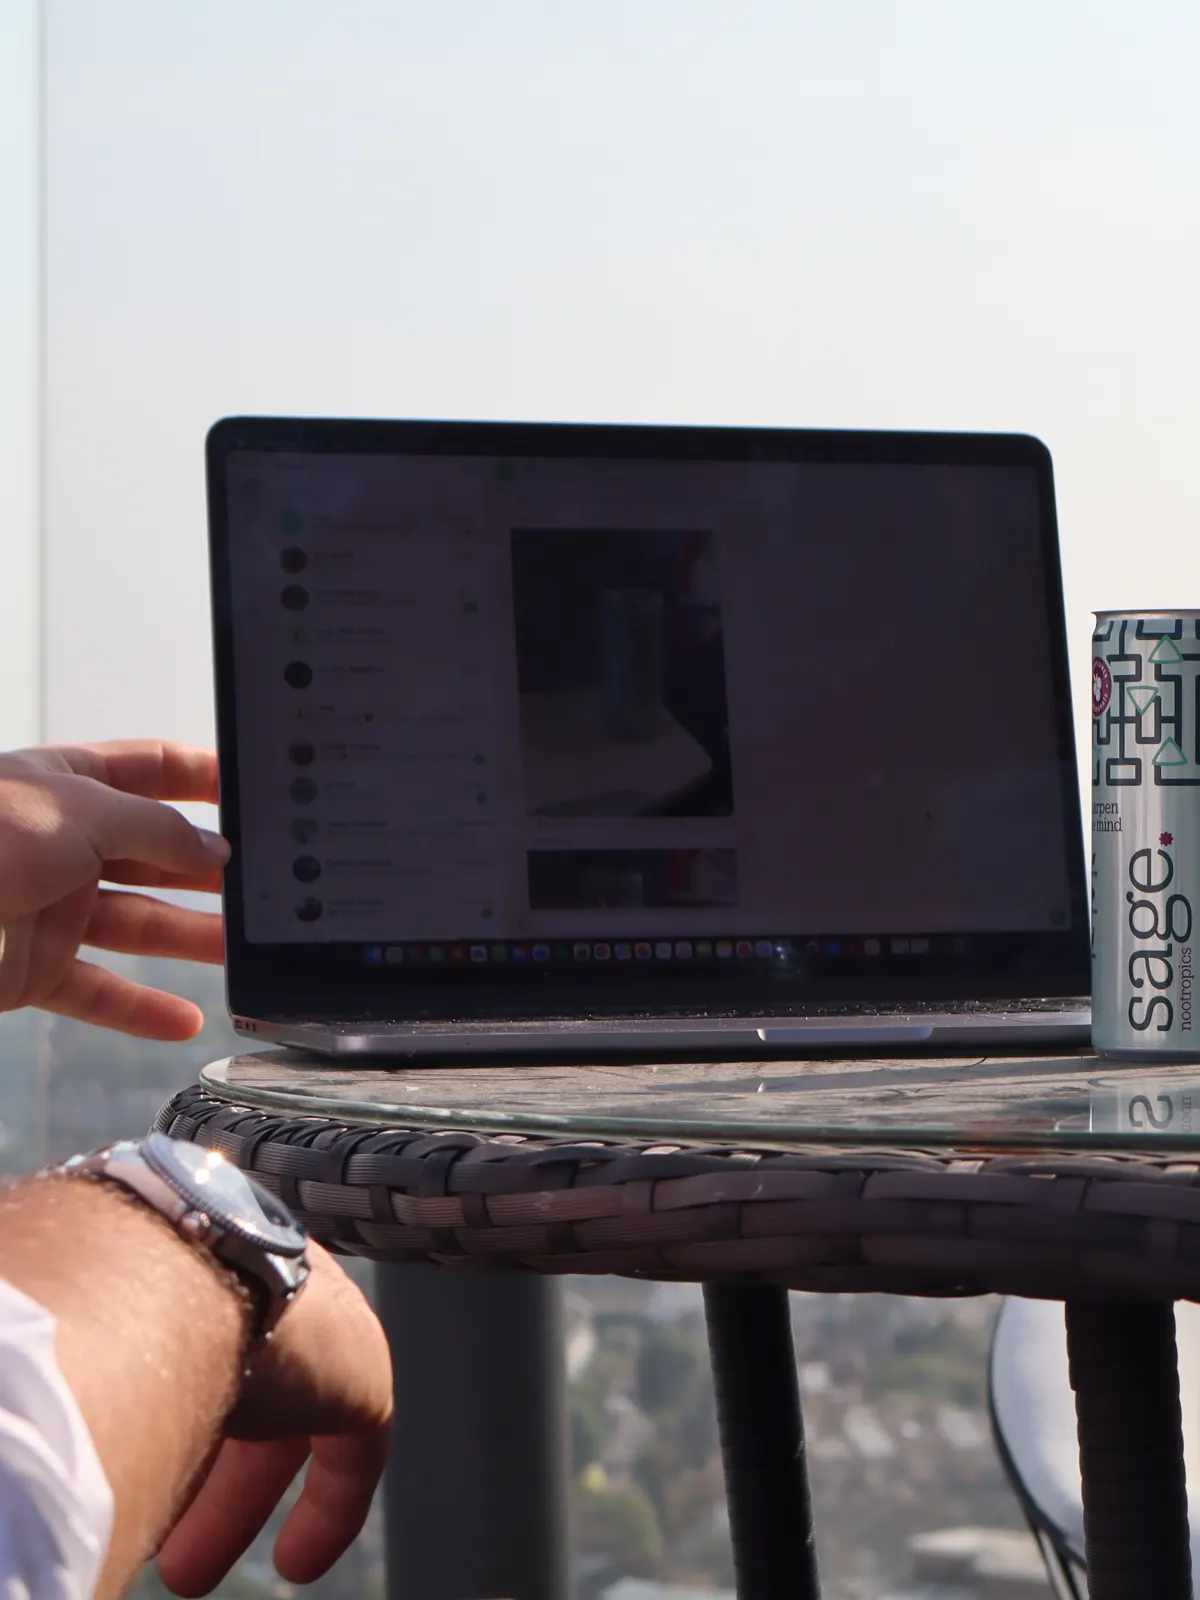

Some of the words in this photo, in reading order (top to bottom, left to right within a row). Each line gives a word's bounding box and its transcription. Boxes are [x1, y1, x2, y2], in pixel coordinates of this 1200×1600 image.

[1091, 802, 1119, 817] arpen
[1096, 817, 1123, 832] mind
[1126, 848, 1192, 1032] sage
[1178, 947, 1195, 1031] nootropics
